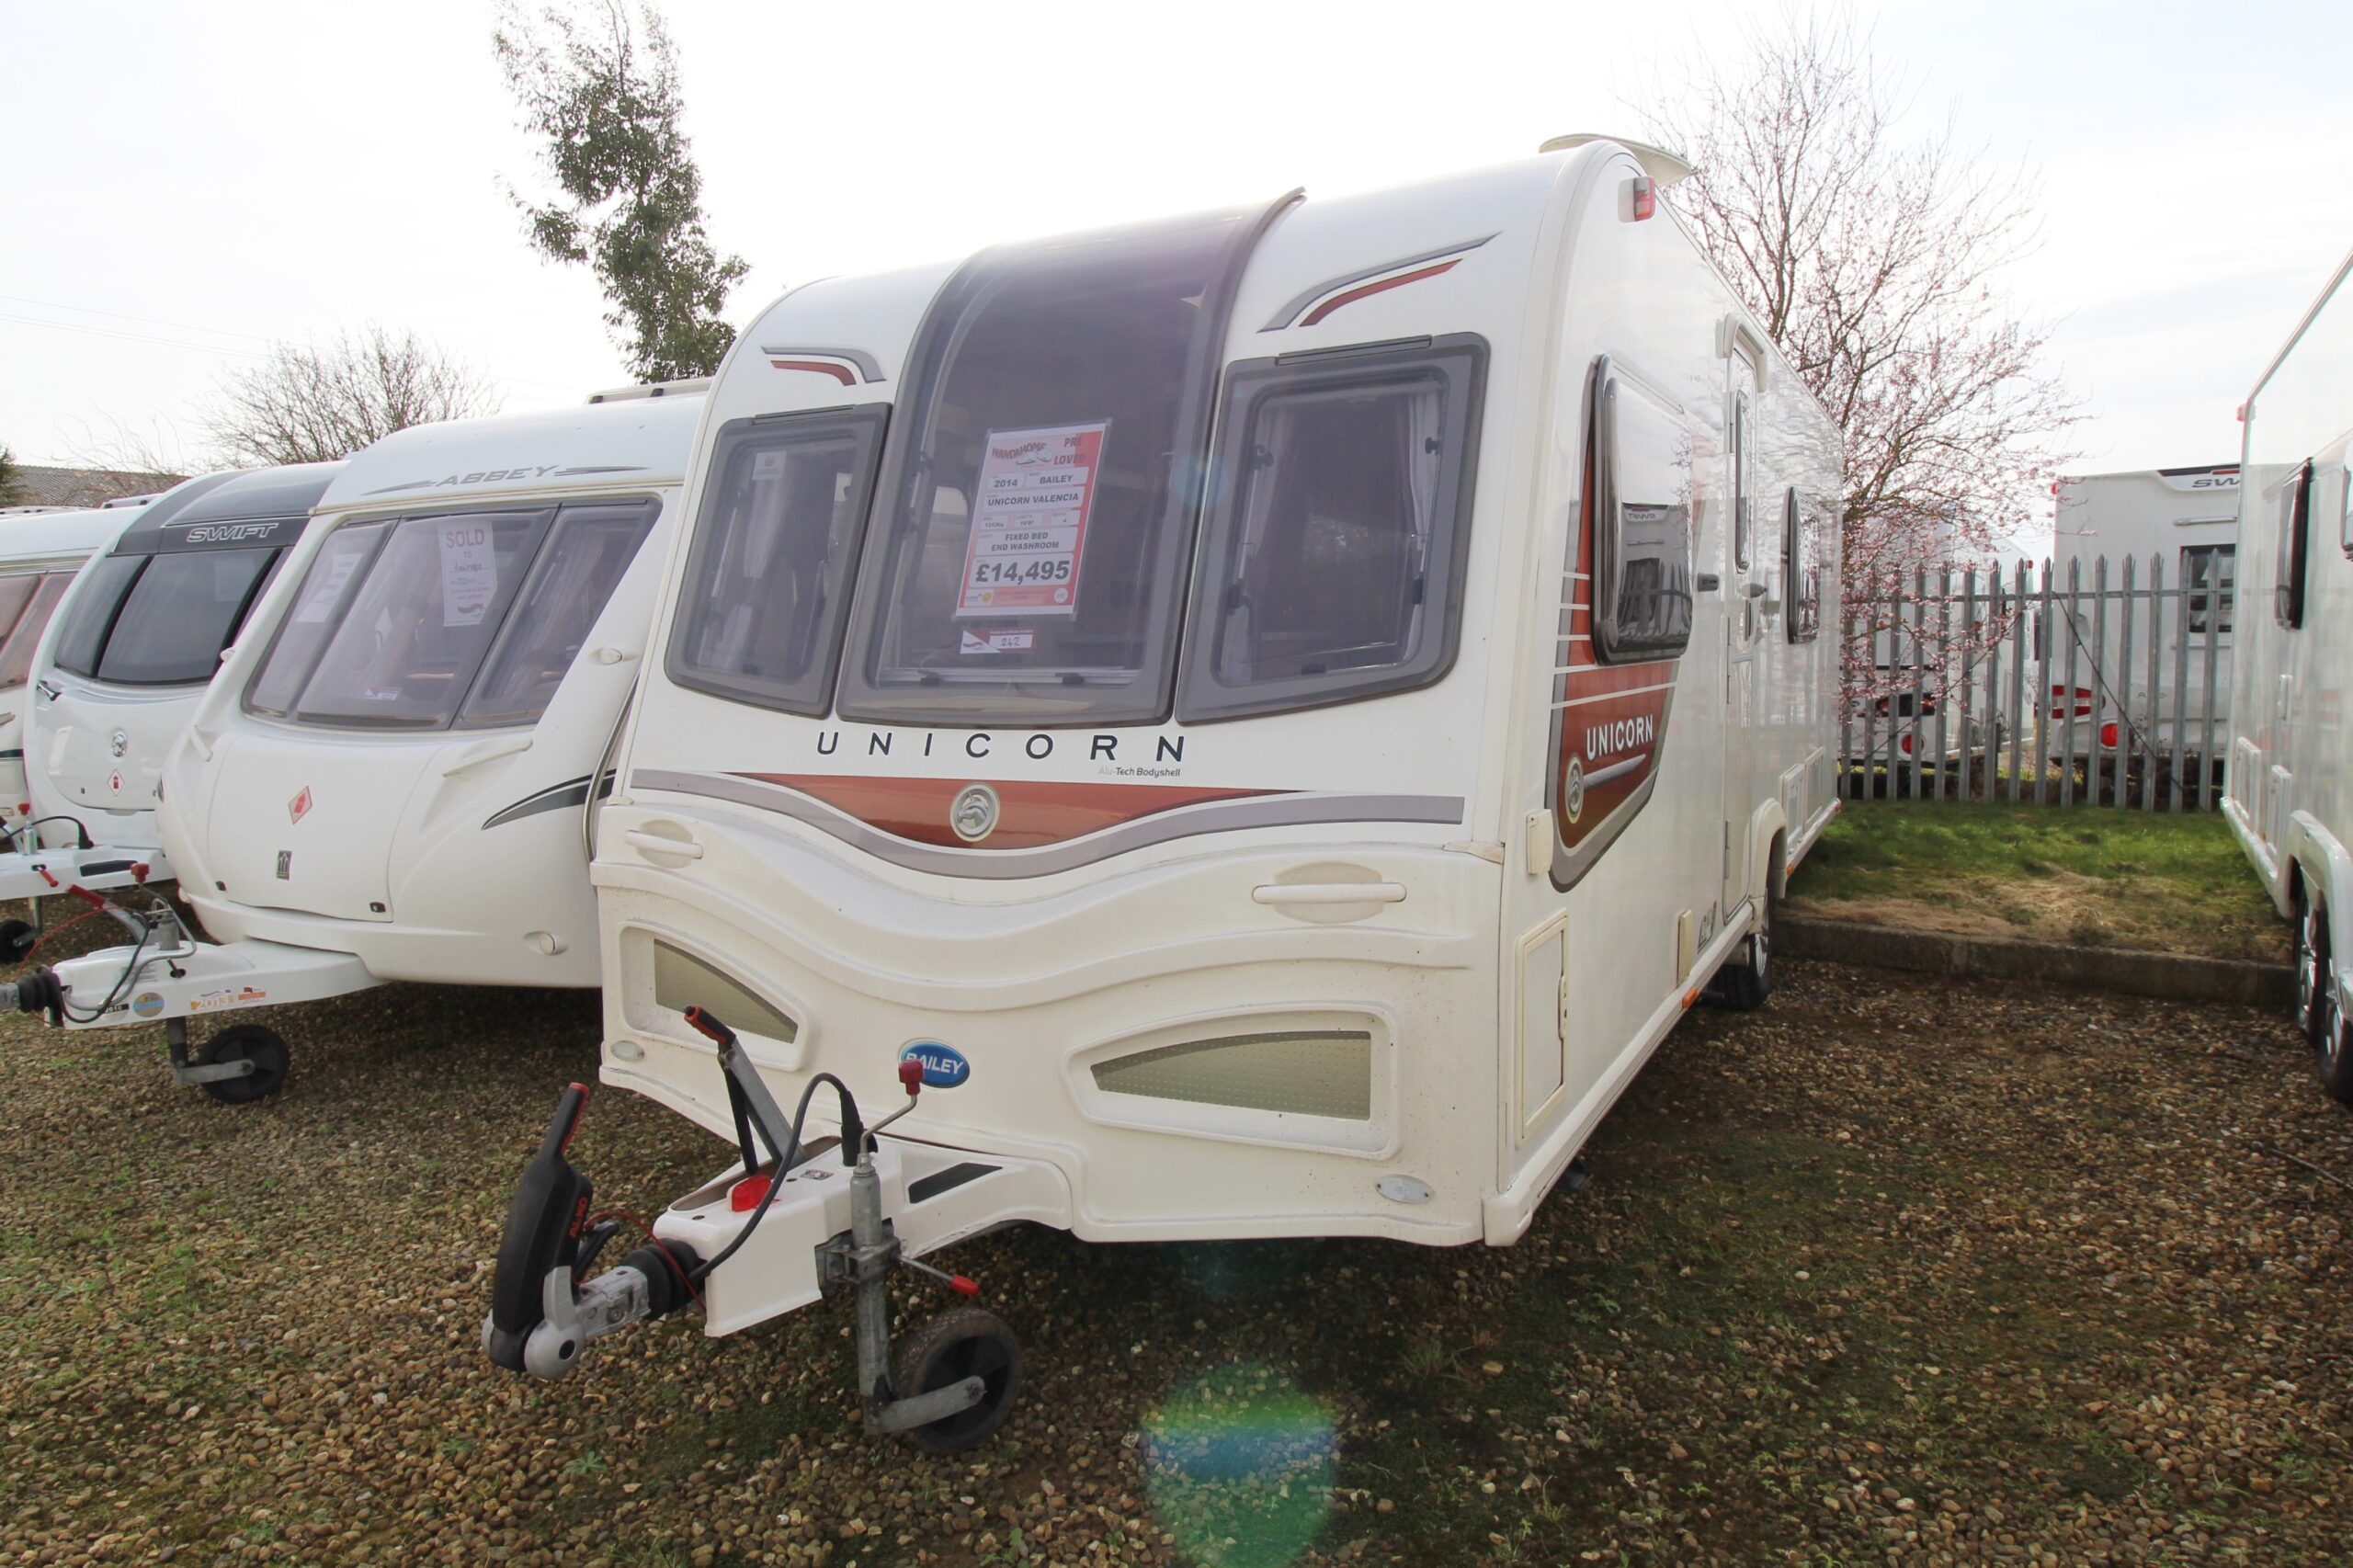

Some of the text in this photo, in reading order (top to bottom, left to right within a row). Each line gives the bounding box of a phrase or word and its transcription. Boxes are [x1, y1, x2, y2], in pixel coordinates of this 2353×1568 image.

[1063, 437, 1084, 448] PRE
[991, 441, 1047, 460] WANDAHOME
[1053, 454, 1086, 466] LOVED
[435, 465, 560, 487] ABBEY
[1039, 474, 1074, 484] BAILEY
[994, 479, 1018, 488] 2014
[2191, 478, 2240, 487] SW
[987, 493, 1079, 506] UNICORN VALENCIA
[187, 523, 279, 542] SWIFT
[447, 528, 485, 549] SOLD
[1031, 532, 1049, 540] BED
[991, 541, 1059, 551] END WASHROOM
[975, 561, 1070, 585] £14,495
[1586, 714, 1653, 761] UNICORN
[816, 732, 1185, 762] UNICORN
[1136, 767, 1181, 778] Bodyshell
